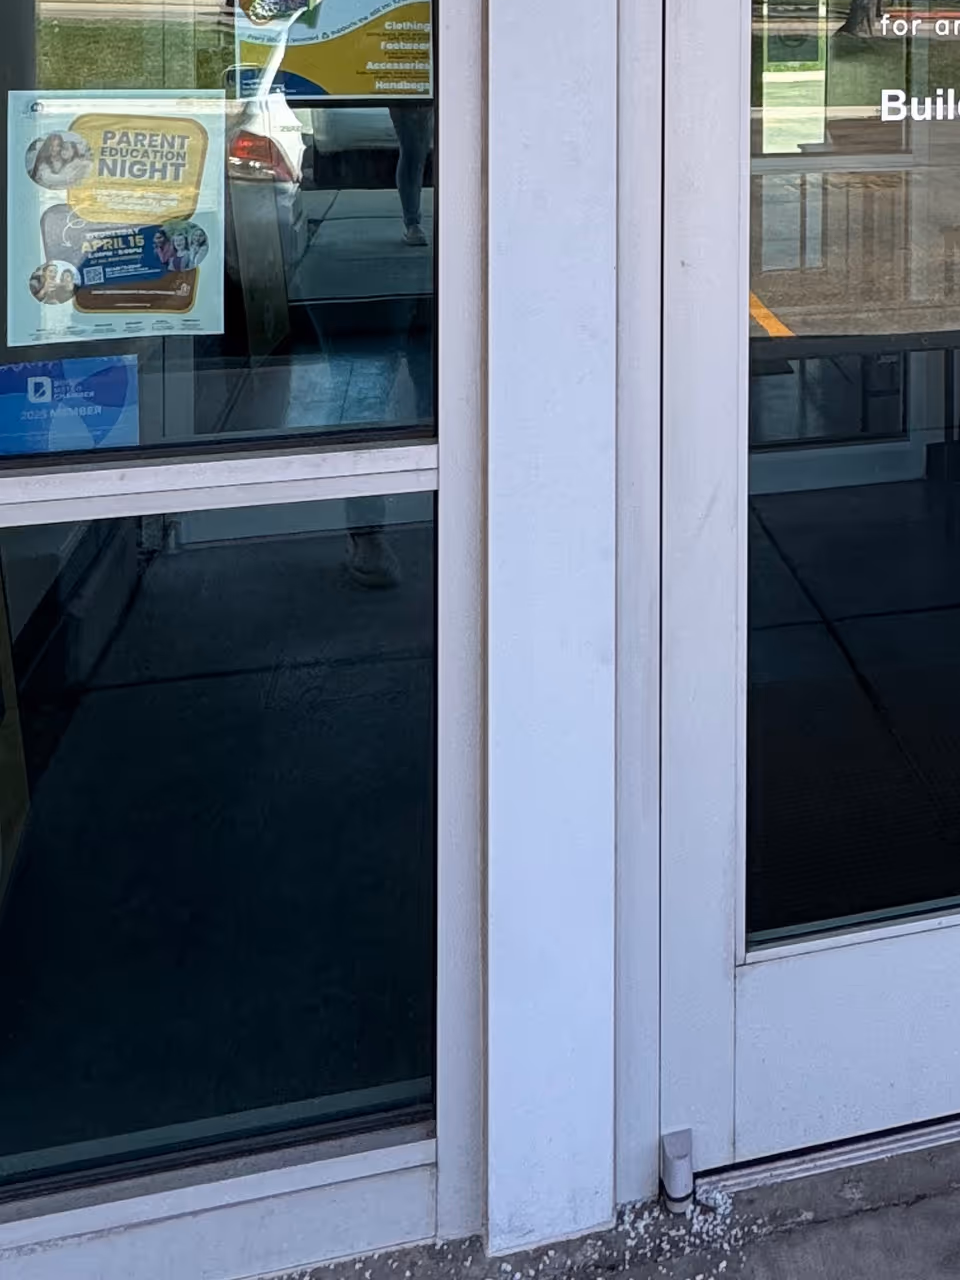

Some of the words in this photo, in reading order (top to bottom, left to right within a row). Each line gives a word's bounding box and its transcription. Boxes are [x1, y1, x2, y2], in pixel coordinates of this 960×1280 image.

[384, 21, 432, 32] Clothing
[880, 14, 922, 36] for
[375, 81, 431, 92] Handbags
[102, 130, 190, 150] PARENT
[100, 146, 187, 162] EDUCATION
[98, 158, 186, 181] NIGHT
[81, 237, 128, 254] APRIL
[50, 405, 102, 418] MMBER
